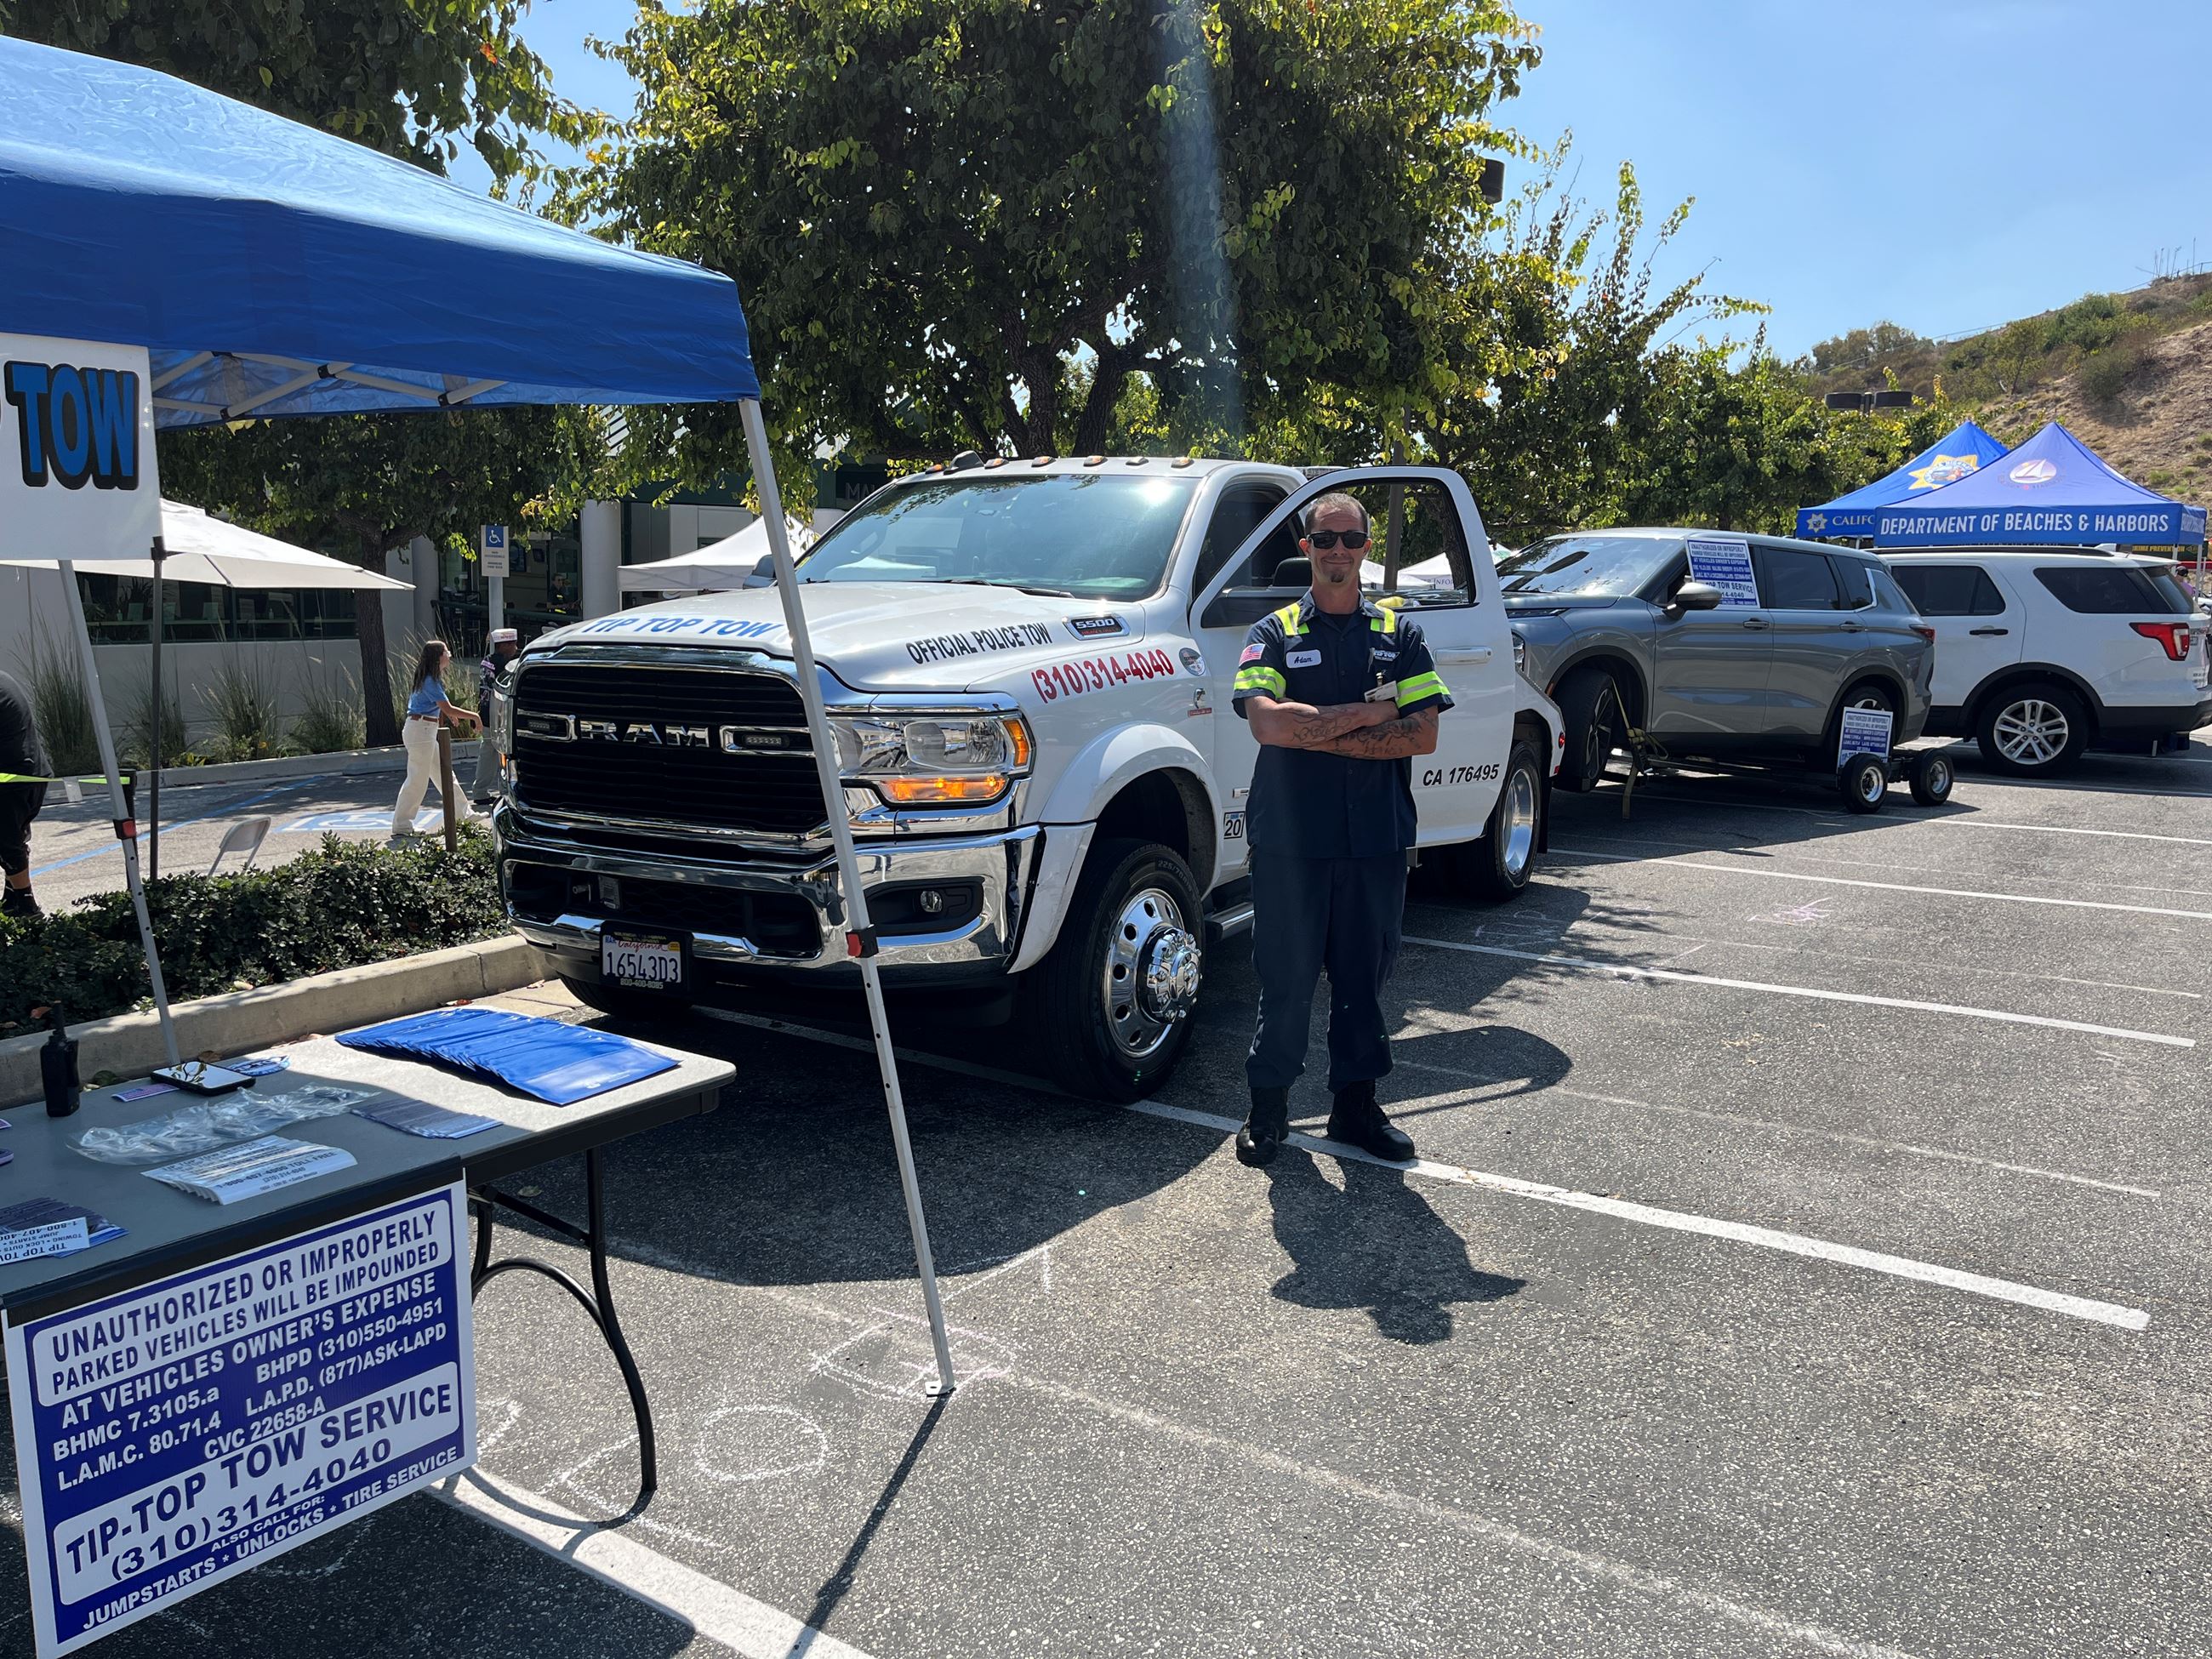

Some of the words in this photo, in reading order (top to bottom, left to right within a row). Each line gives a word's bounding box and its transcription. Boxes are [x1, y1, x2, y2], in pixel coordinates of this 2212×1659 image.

[4, 361, 139, 490] TOW
[1880, 515, 1975, 535] DEPARTMENT
[1981, 514, 1999, 532] OF
[2004, 512, 2072, 531] BEACHES
[2078, 514, 2089, 531] &
[2095, 514, 2169, 532] HARBORS
[1731, 583, 1753, 594] SERVICE
[584, 618, 636, 633] TIP
[638, 618, 697, 633] TOP
[699, 619, 784, 638] TOW
[1075, 619, 1115, 629] 5500
[905, 632, 976, 665] OFFICIAL
[972, 624, 1027, 652] POLICE
[1019, 621, 1053, 647] TOW
[1031, 648, 1175, 704] (310)314-4040
[579, 721, 710, 748] RAM
[1422, 769, 1442, 786] CA
[1449, 763, 1500, 784] 176495
[1223, 819, 1241, 836] 20
[619, 940, 668, 953] California
[606, 951, 679, 982] 16543D3
[3, 1243, 24, 1252] OUTS
[9, 1234, 37, 1245] STARTS
[23, 1247, 45, 1257] TOP
[26, 1240, 45, 1248] LOCK
[48, 1242, 67, 1251] TIP
[53, 1233, 83, 1243] TOWING
[52, 1272, 254, 1363] UNAUTHORIZED
[262, 1259, 294, 1291] OR
[301, 1210, 436, 1279] IMPROPERLY
[52, 1346, 138, 1395] PARKED
[145, 1308, 248, 1362] VEHICLES
[254, 1291, 299, 1323] WILL
[306, 1279, 329, 1305] BE
[336, 1241, 439, 1295] IMPOUNDED
[62, 1396, 93, 1429] AT
[100, 1349, 225, 1413] VEHICLES
[232, 1309, 334, 1365] OWNER'S
[341, 1272, 436, 1325] EXPENSE
[53, 1419, 122, 1462] BHMC
[128, 1387, 220, 1432] 7.3105.a
[256, 1348, 312, 1384] BHPD
[317, 1297, 442, 1361] (310)550-4951
[58, 1444, 144, 1491] L.A.M.C.
[149, 1410, 222, 1455] 80.71.4
[246, 1377, 314, 1417] L.A.P.D.
[319, 1321, 447, 1388] (877)ASK-LAPD
[204, 1428, 246, 1460] CVC
[250, 1396, 327, 1442] 22658-A
[66, 1471, 207, 1575] TIP-TOP
[220, 1427, 306, 1489] TOW
[320, 1383, 452, 1449] SERVICE
[111, 1438, 391, 1581] (310)314-4040
[210, 1530, 249, 1553] ALSO
[254, 1513, 290, 1532] CALL
[294, 1495, 326, 1515] FOR:
[83, 1557, 216, 1630] JUMPSTARTS
[236, 1508, 324, 1559] UNLOCKS
[342, 1480, 383, 1510] TIRE
[386, 1446, 458, 1491] SERVICE
